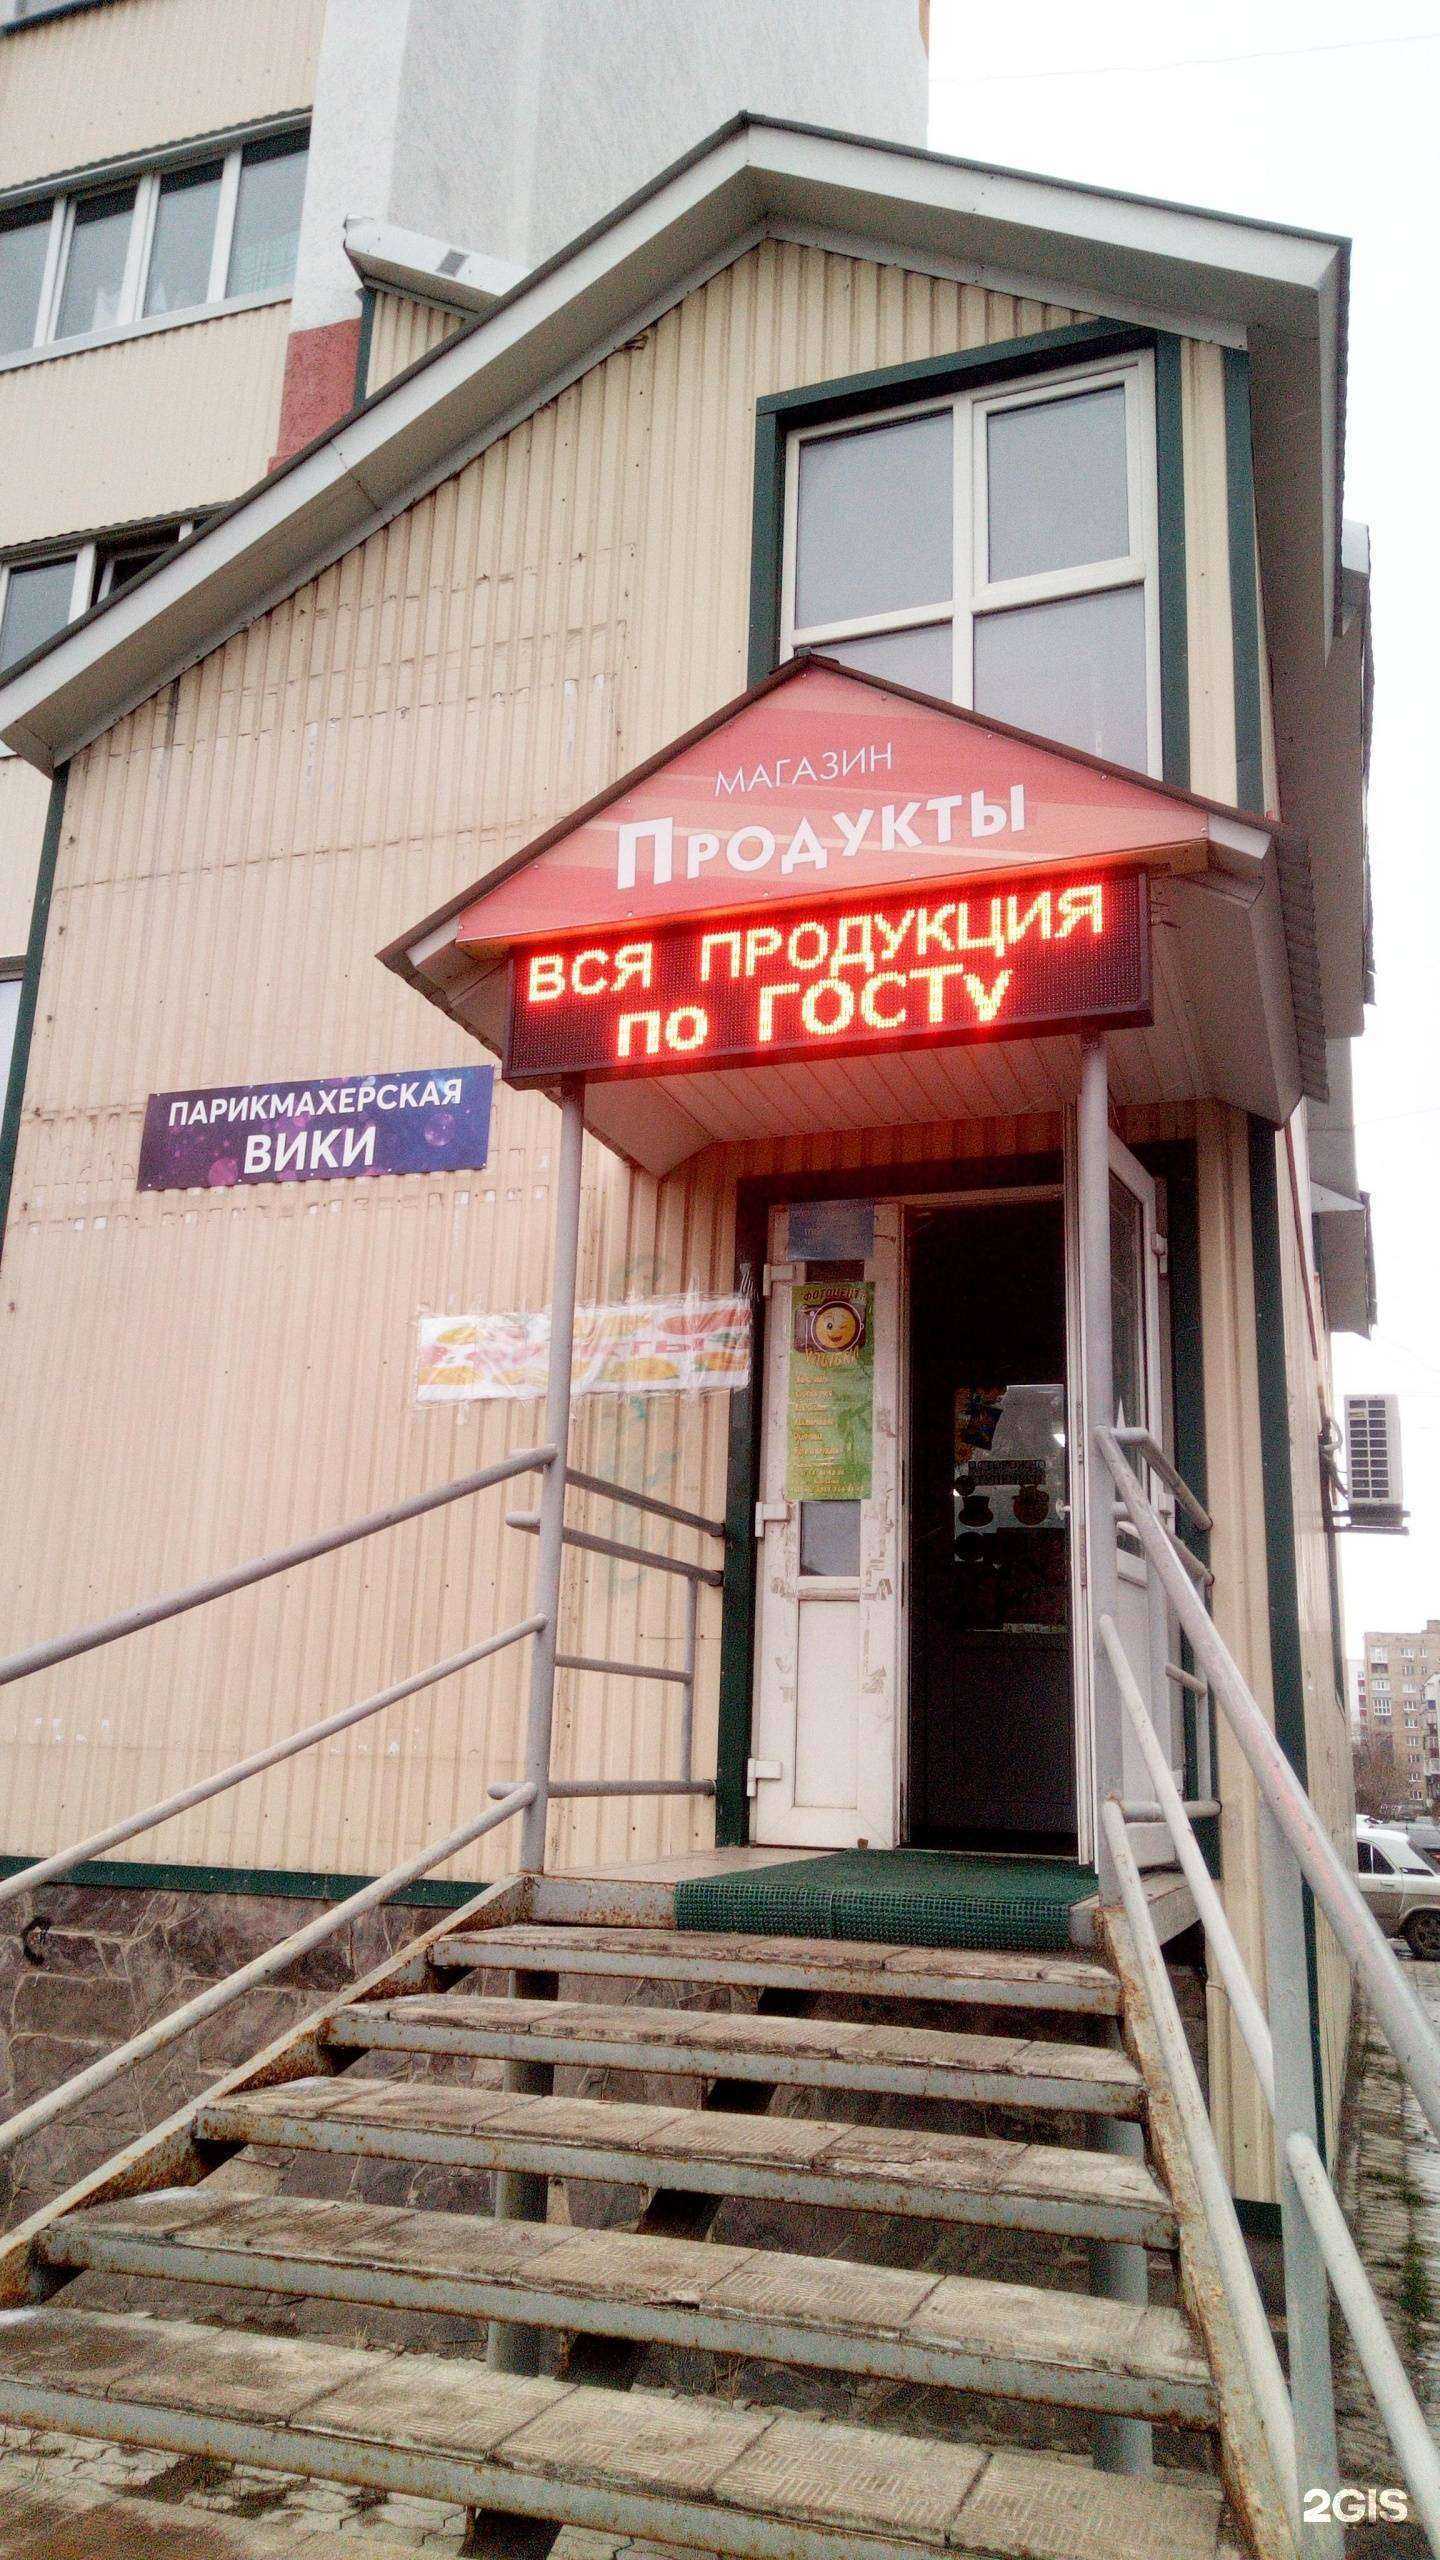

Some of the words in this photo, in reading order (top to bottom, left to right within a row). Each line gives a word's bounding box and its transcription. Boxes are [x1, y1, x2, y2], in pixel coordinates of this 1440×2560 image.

[714, 742, 893, 797] МАГАЗИН
[617, 784, 1025, 890] ПРОДУКТЫ
[528, 942, 653, 1003] ВСЯ
[700, 884, 1103, 983] ПРОДУКЦИЯ
[168, 1078, 463, 1127] ПАРИКМАХЕРСКАЯ
[243, 1126, 376, 1174] ВИКИ
